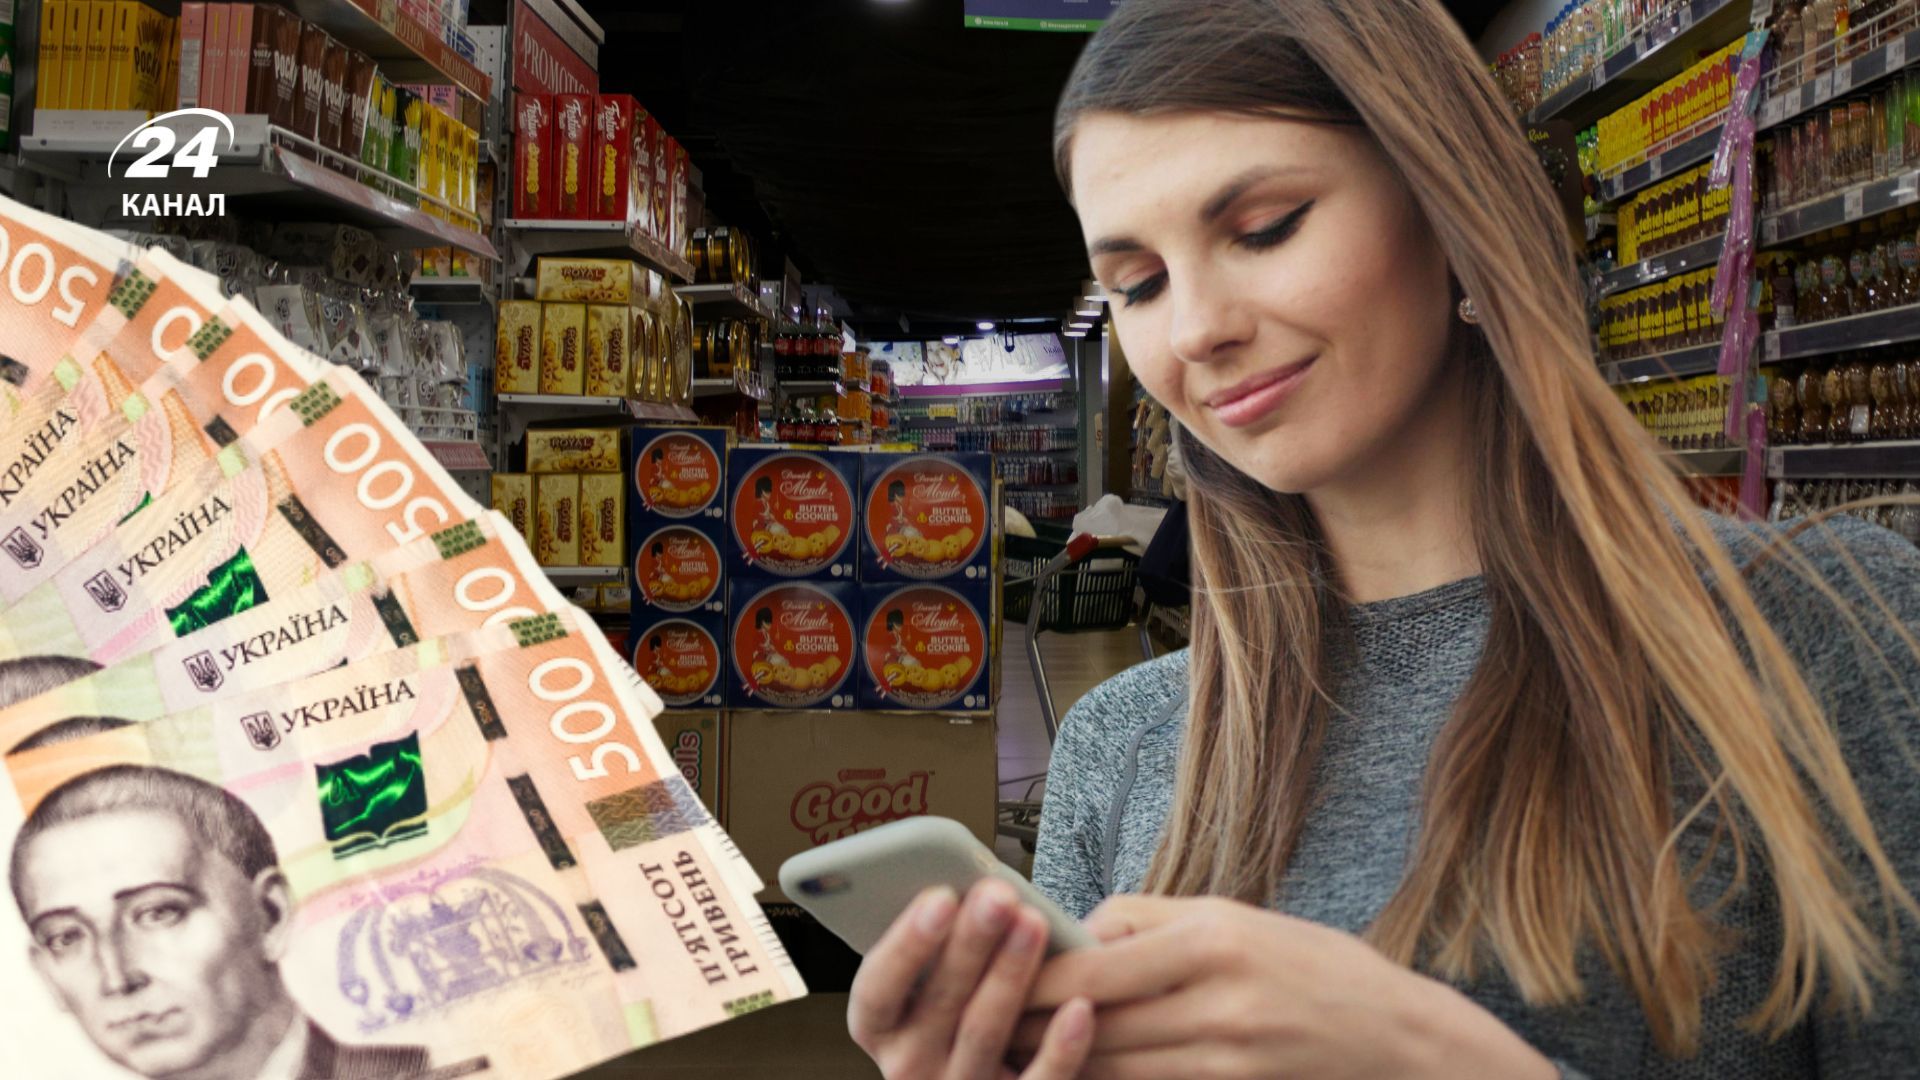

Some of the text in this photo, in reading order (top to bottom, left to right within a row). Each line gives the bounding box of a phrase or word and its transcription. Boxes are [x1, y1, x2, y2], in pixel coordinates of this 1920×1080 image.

[440, 51, 482, 94] PROMOTION
[522, 31, 590, 95] PROMOT
[526, 98, 542, 139] Festive
[565, 98, 582, 140] Festive
[604, 100, 620, 142] Festive
[0, 222, 98, 329] 50
[562, 268, 604, 278] ROYAL
[521, 327, 532, 367] ROYAL
[565, 328, 576, 367] ROYAL
[612, 330, 623, 370] ROYAL
[0, 409, 77, 507] КРАЇНА
[551, 438, 592, 448] ROYAL
[31, 440, 136, 540] УКРАЇНА
[324, 422, 449, 545] 500
[780, 481, 832, 500] Monde
[912, 484, 963, 503] Monde
[515, 500, 526, 533] ROYA
[560, 500, 571, 540] ROYAL
[604, 500, 614, 540] ROYAL
[795, 513, 839, 522] COOKIES
[799, 505, 835, 513] BUTTER
[928, 515, 972, 523] COOKIES
[932, 507, 968, 515] BUTTER
[118, 496, 232, 586] УКРАЇНА
[220, 604, 349, 670] УКРАЇНА
[780, 611, 833, 632] Monde
[799, 635, 836, 644] BUTTER
[911, 612, 963, 632] Monde
[930, 635, 967, 643] BUTTER
[795, 643, 839, 652] COOKIES
[926, 643, 971, 652] COOKIES
[281, 679, 415, 733] УКРАЇНА
[528, 657, 641, 781] 500
[674, 733, 699, 788] olls
[791, 771, 928, 831] Good
[638, 862, 728, 986] П'ЯТСОТ
[673, 850, 759, 978] ГРИВЕНЬ
